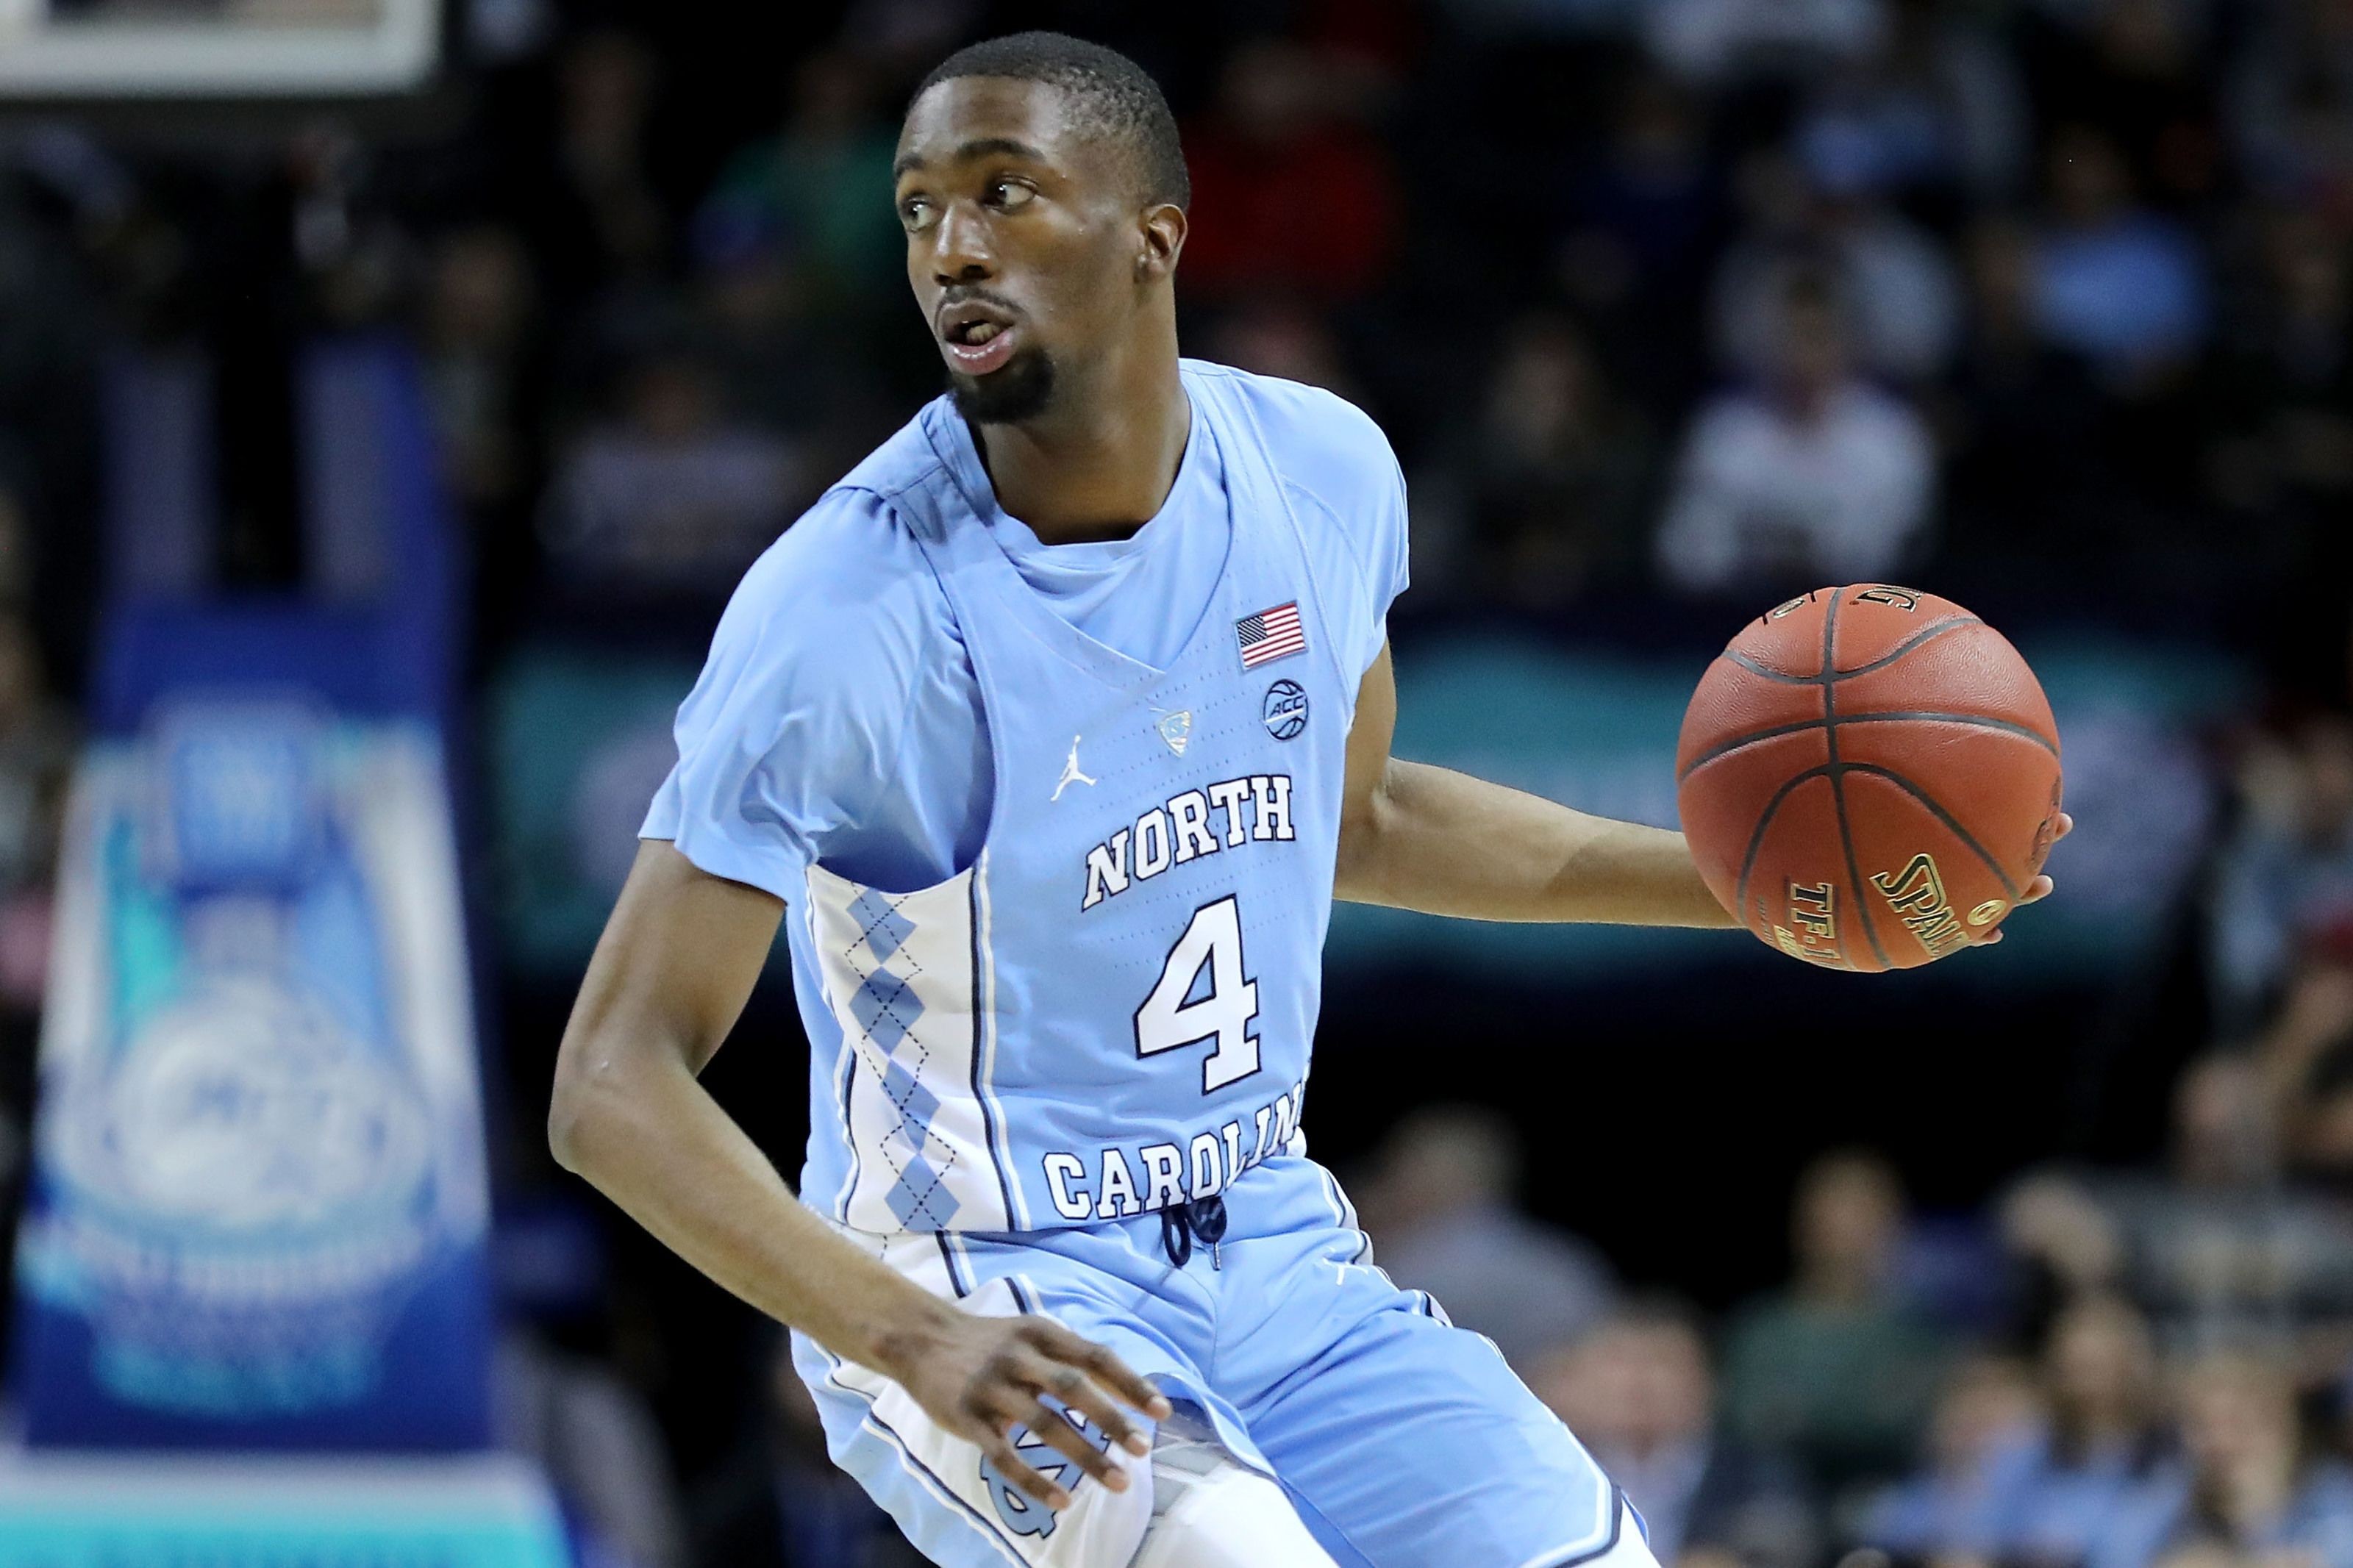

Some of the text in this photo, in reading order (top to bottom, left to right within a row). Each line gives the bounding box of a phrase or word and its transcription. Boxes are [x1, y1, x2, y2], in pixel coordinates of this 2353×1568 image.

[1269, 694, 1304, 717] ACC
[1080, 773, 1296, 912] NORTH
[1133, 892, 1263, 1096] 4
[1042, 1070, 1309, 1220] CAROLIN
